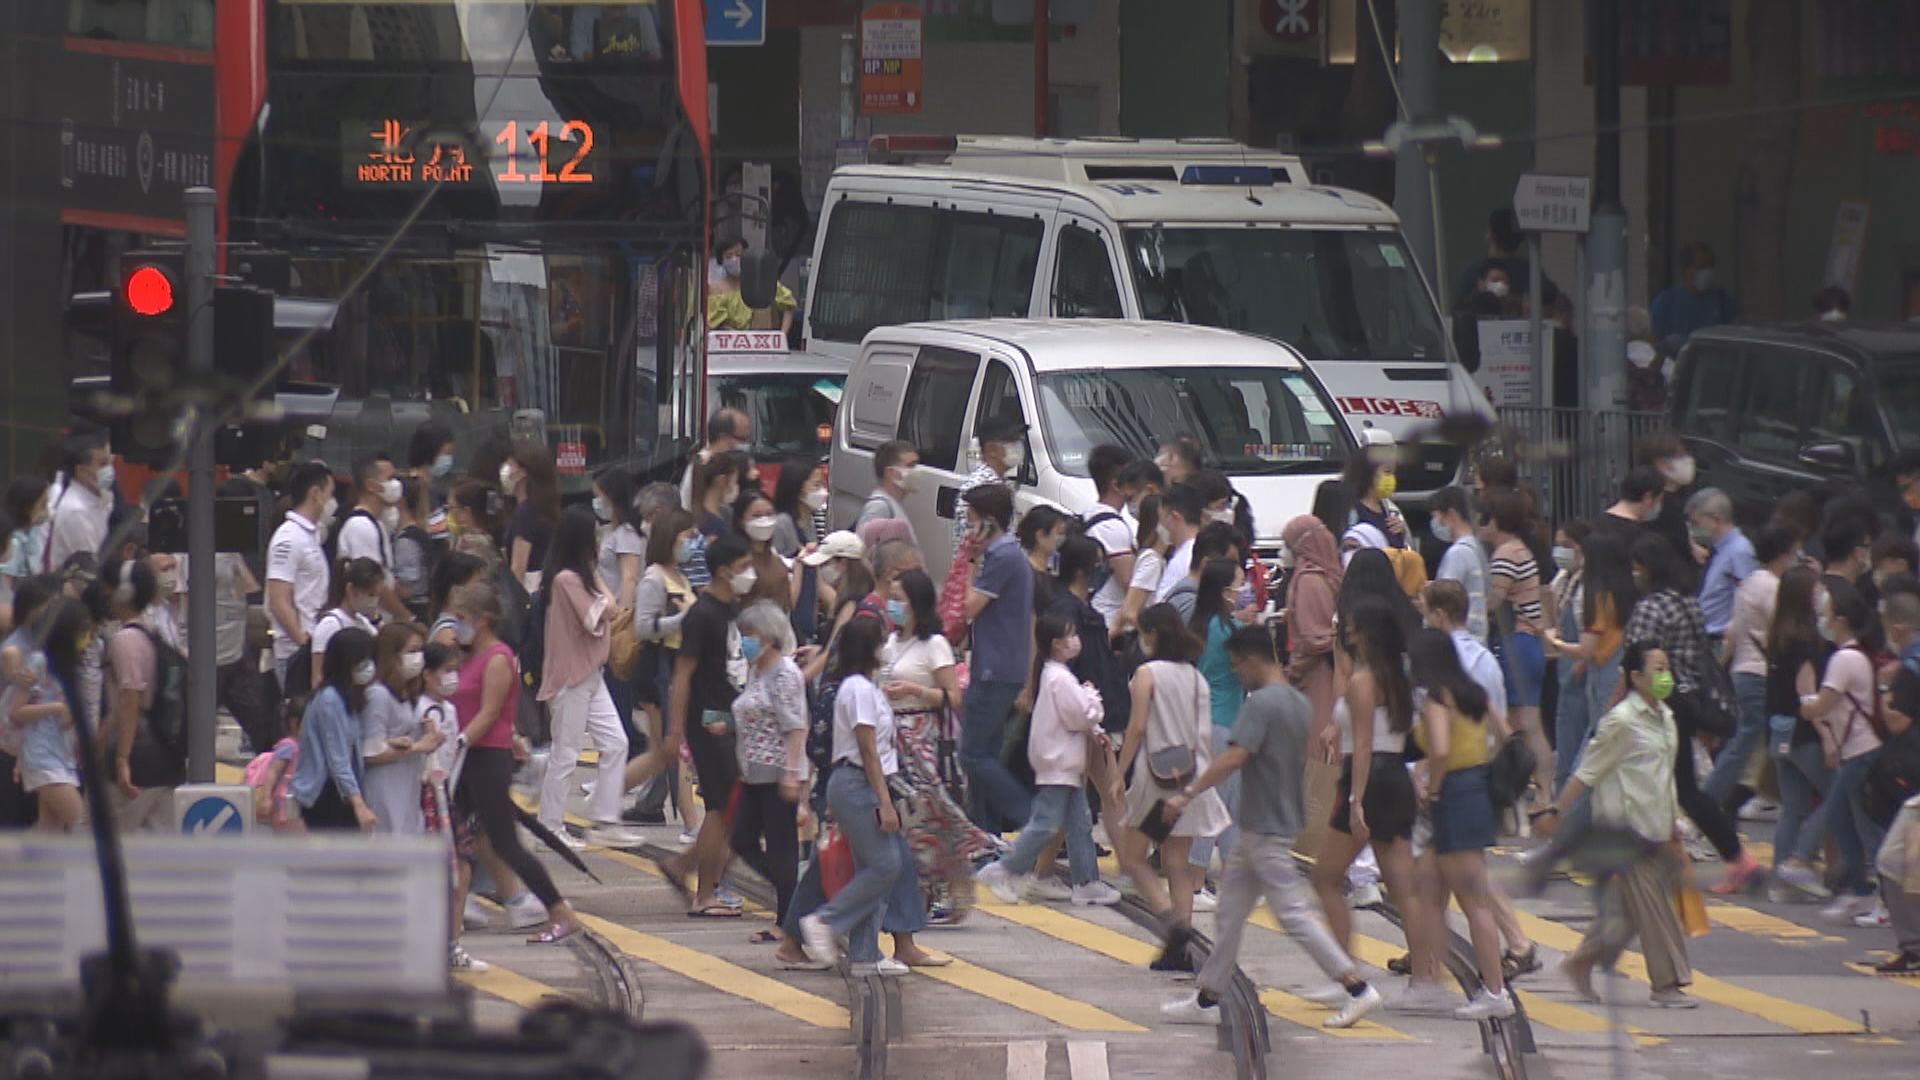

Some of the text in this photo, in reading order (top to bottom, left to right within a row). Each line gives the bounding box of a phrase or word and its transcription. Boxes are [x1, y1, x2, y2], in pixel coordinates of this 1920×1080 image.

[495, 119, 594, 182] 112
[358, 164, 411, 182] NORTH
[715, 334, 781, 349] TAXI
[1340, 397, 1417, 416] LICE
